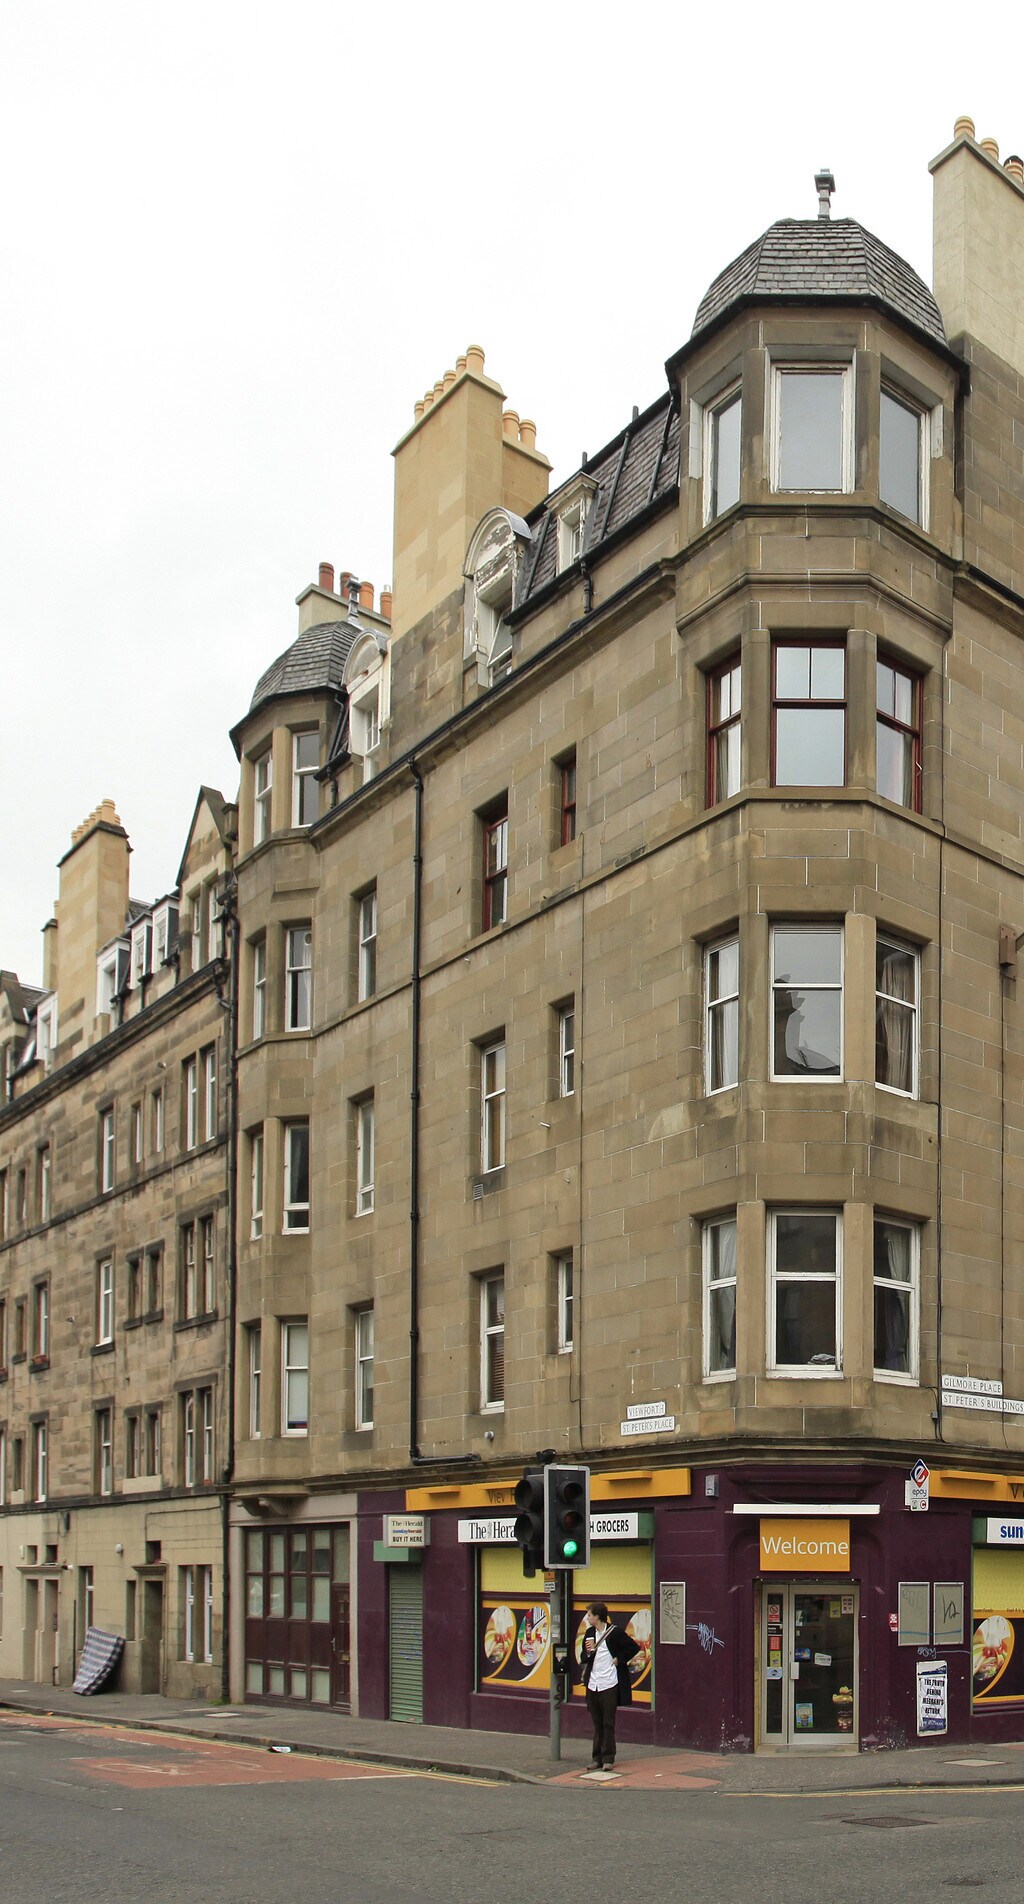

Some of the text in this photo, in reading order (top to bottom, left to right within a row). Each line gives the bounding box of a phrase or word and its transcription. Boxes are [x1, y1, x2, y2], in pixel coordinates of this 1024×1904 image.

[943, 1377, 1001, 1393] GILMORE PLACE
[628, 1405, 665, 1417] VIEWFORTH
[986, 1399, 1024, 1412] BUILDINGS
[631, 1421, 653, 1432] PETER'S
[654, 1417, 673, 1429] PLACE
[912, 1489, 927, 1498] epay
[468, 1520, 516, 1540] The Hera
[592, 1519, 630, 1533] GROCERS
[761, 1536, 849, 1555] Welcome
